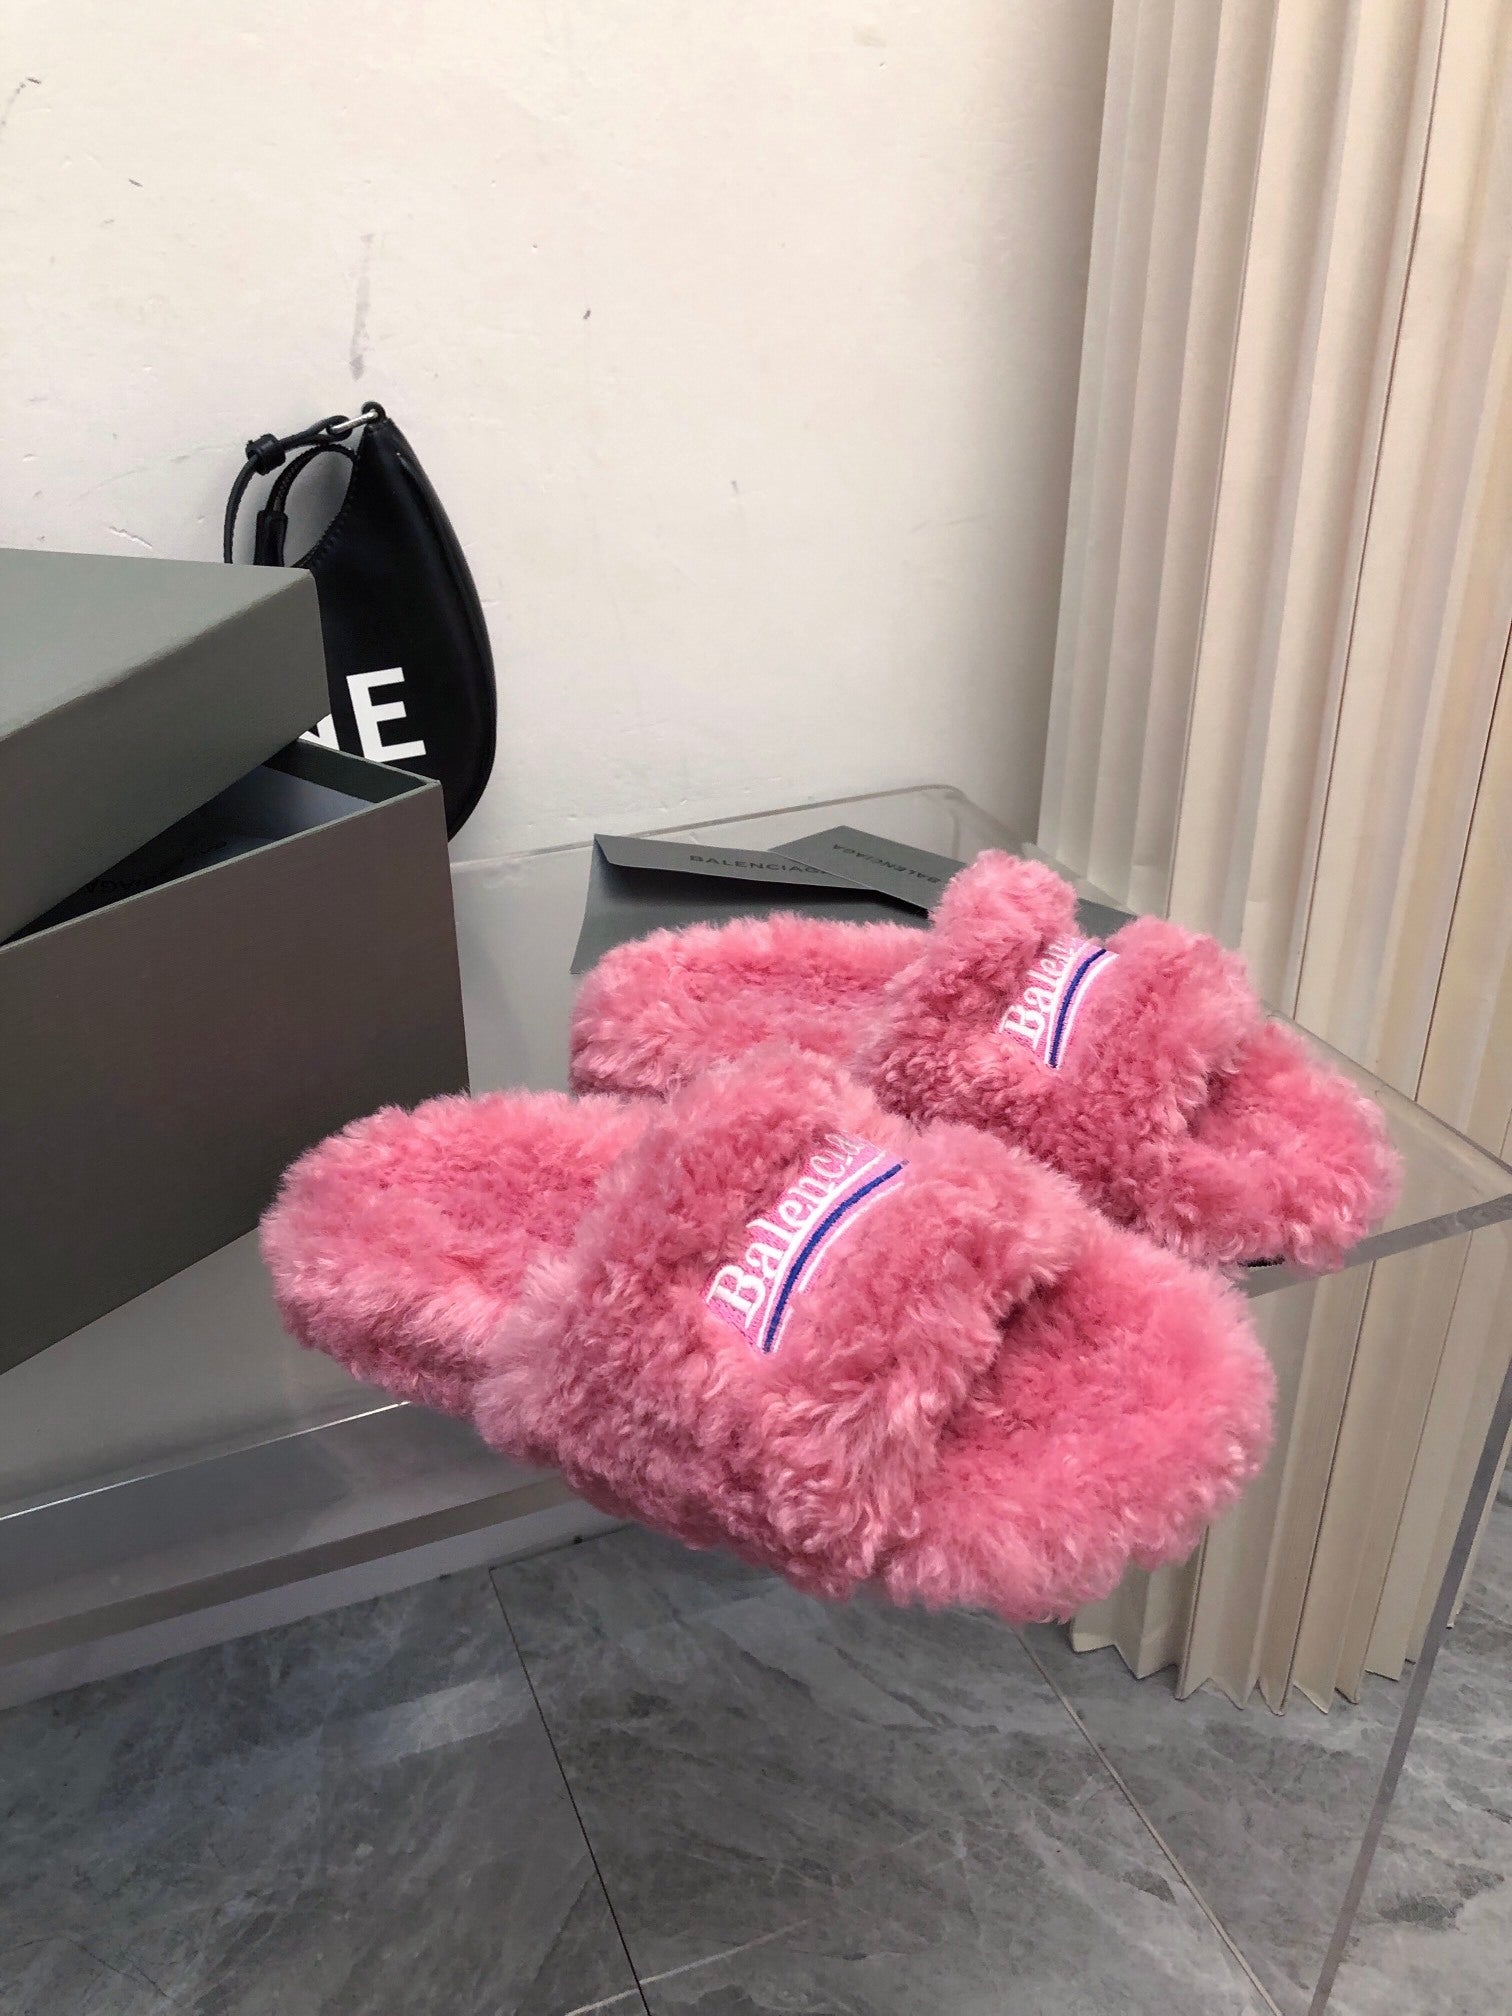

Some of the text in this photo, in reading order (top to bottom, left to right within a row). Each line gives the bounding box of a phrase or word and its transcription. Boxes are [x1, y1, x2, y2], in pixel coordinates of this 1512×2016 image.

[689, 855, 827, 874] BALENCIAG
[833, 844, 941, 883] BALENCIAGA
[998, 940, 1075, 1050] Balen
